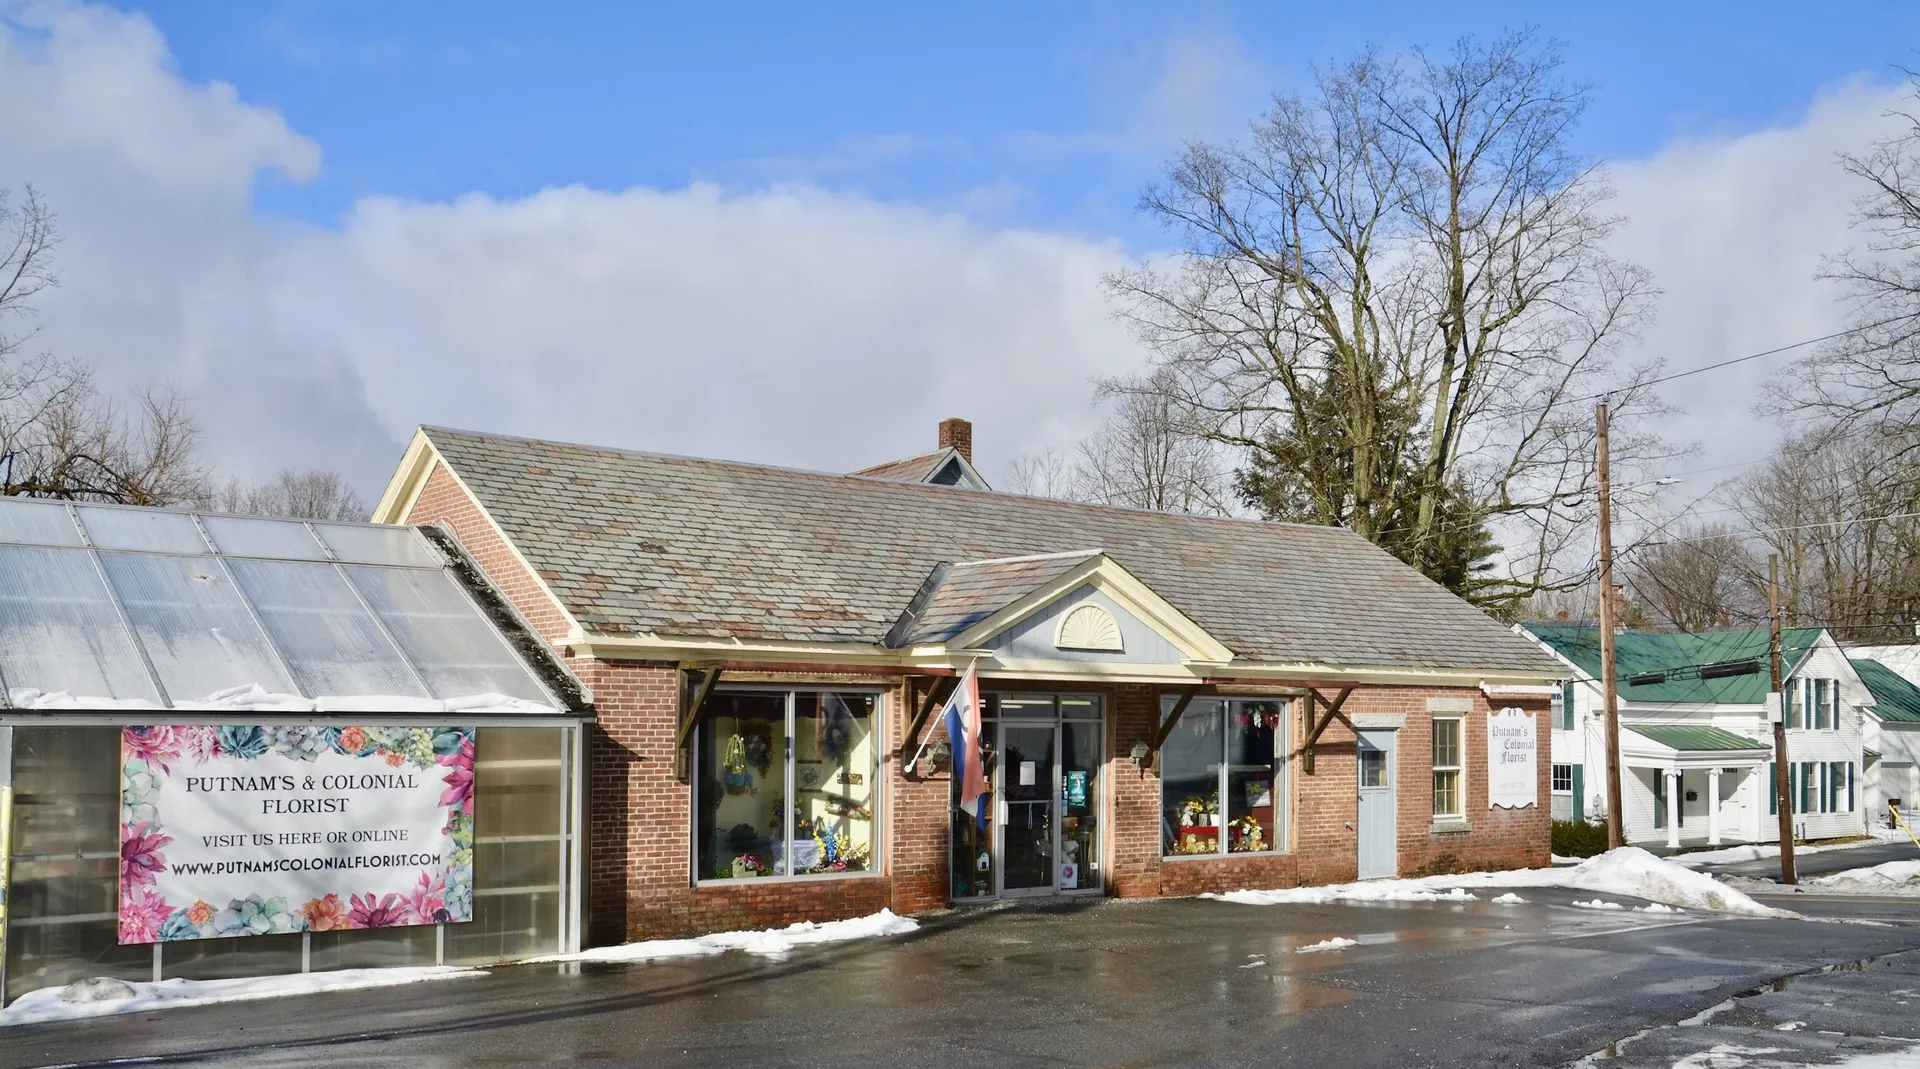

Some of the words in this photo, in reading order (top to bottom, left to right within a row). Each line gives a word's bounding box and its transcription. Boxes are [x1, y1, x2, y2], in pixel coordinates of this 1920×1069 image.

[1491, 725, 1528, 739] Putnam's
[1503, 738, 1535, 750] Colonial
[1499, 751, 1527, 765] Florist
[185, 774, 296, 793] PUTNAM'S
[301, 774, 316, 791] &
[322, 773, 419, 791] COLONIAL
[262, 797, 350, 815] FLORIST
[201, 834, 248, 848] VISIT
[252, 833, 274, 847] US
[278, 832, 323, 846] HERE
[326, 831, 348, 845] OR
[351, 829, 409, 844] ONLINE
[171, 853, 441, 876] WWW.PUTNAMSCOLONIALFLORIST.COM
